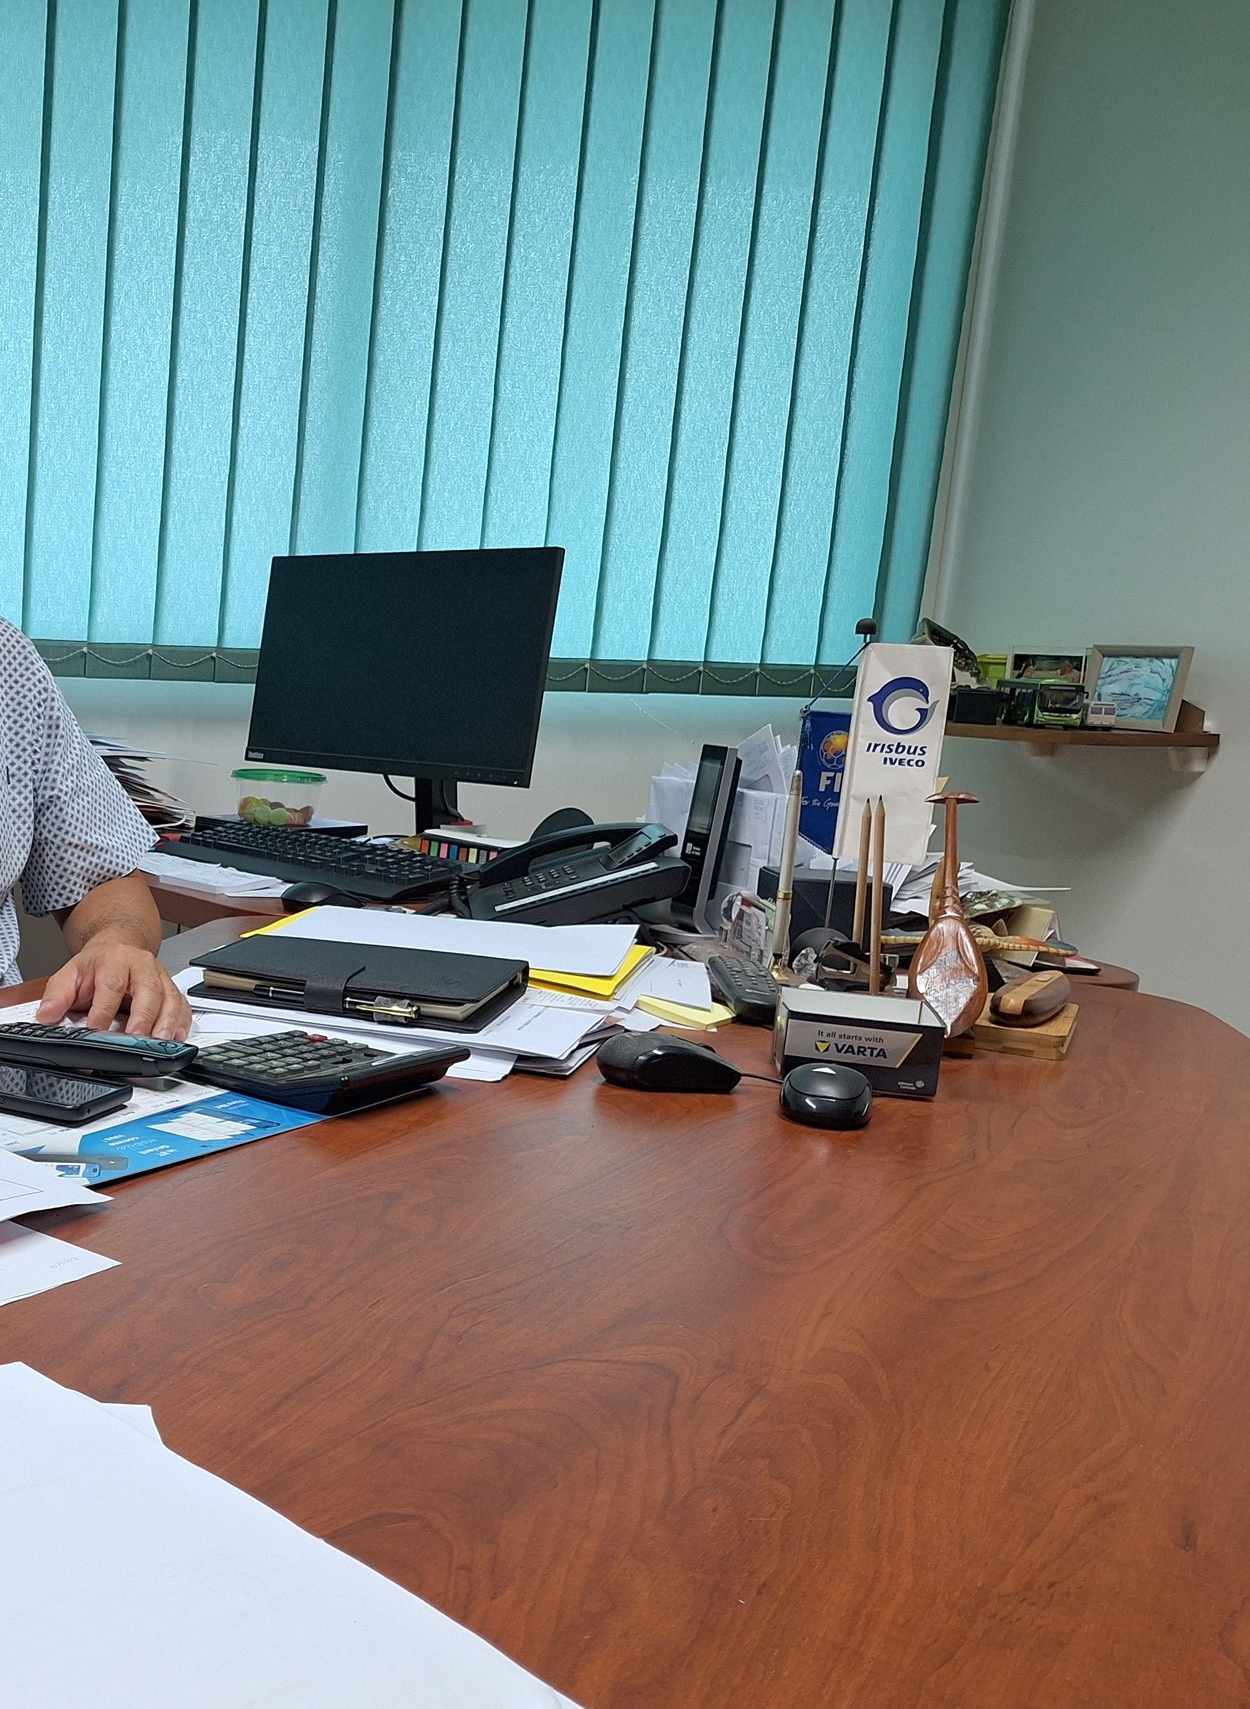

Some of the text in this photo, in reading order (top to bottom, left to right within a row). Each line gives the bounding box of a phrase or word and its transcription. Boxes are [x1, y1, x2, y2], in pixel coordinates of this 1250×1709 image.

[866, 742, 927, 756] irisbus
[882, 757, 926, 768] IVECO
[819, 771, 842, 792] FI
[817, 1029, 884, 1044] It all starts with
[834, 1042, 887, 1059] VARTA
